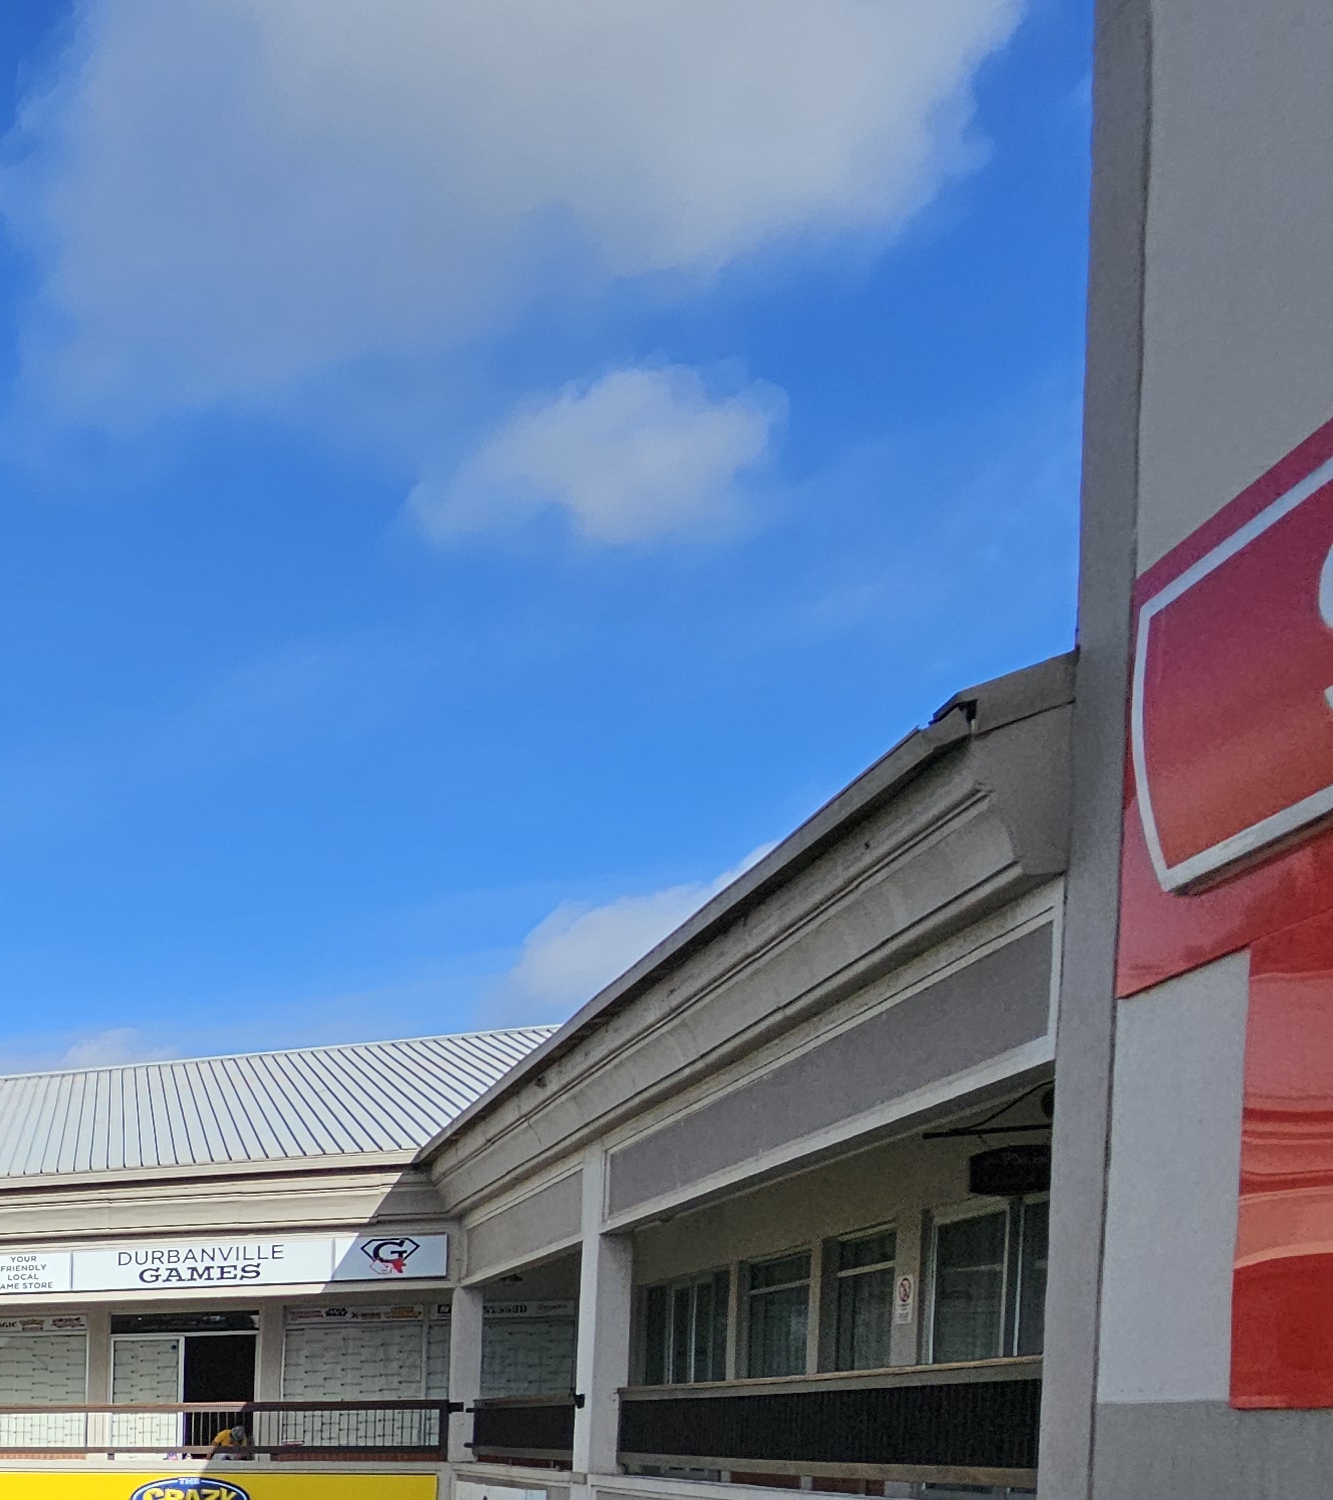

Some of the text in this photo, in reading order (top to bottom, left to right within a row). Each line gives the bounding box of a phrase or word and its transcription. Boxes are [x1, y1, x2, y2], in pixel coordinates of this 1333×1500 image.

[117, 1244, 284, 1267] DURBANVILLE
[0, 1264, 47, 1272] FRIENDLY
[7, 1273, 39, 1281] LOCAL
[139, 1263, 261, 1283] GAMES
[22, 1281, 54, 1290] STORE
